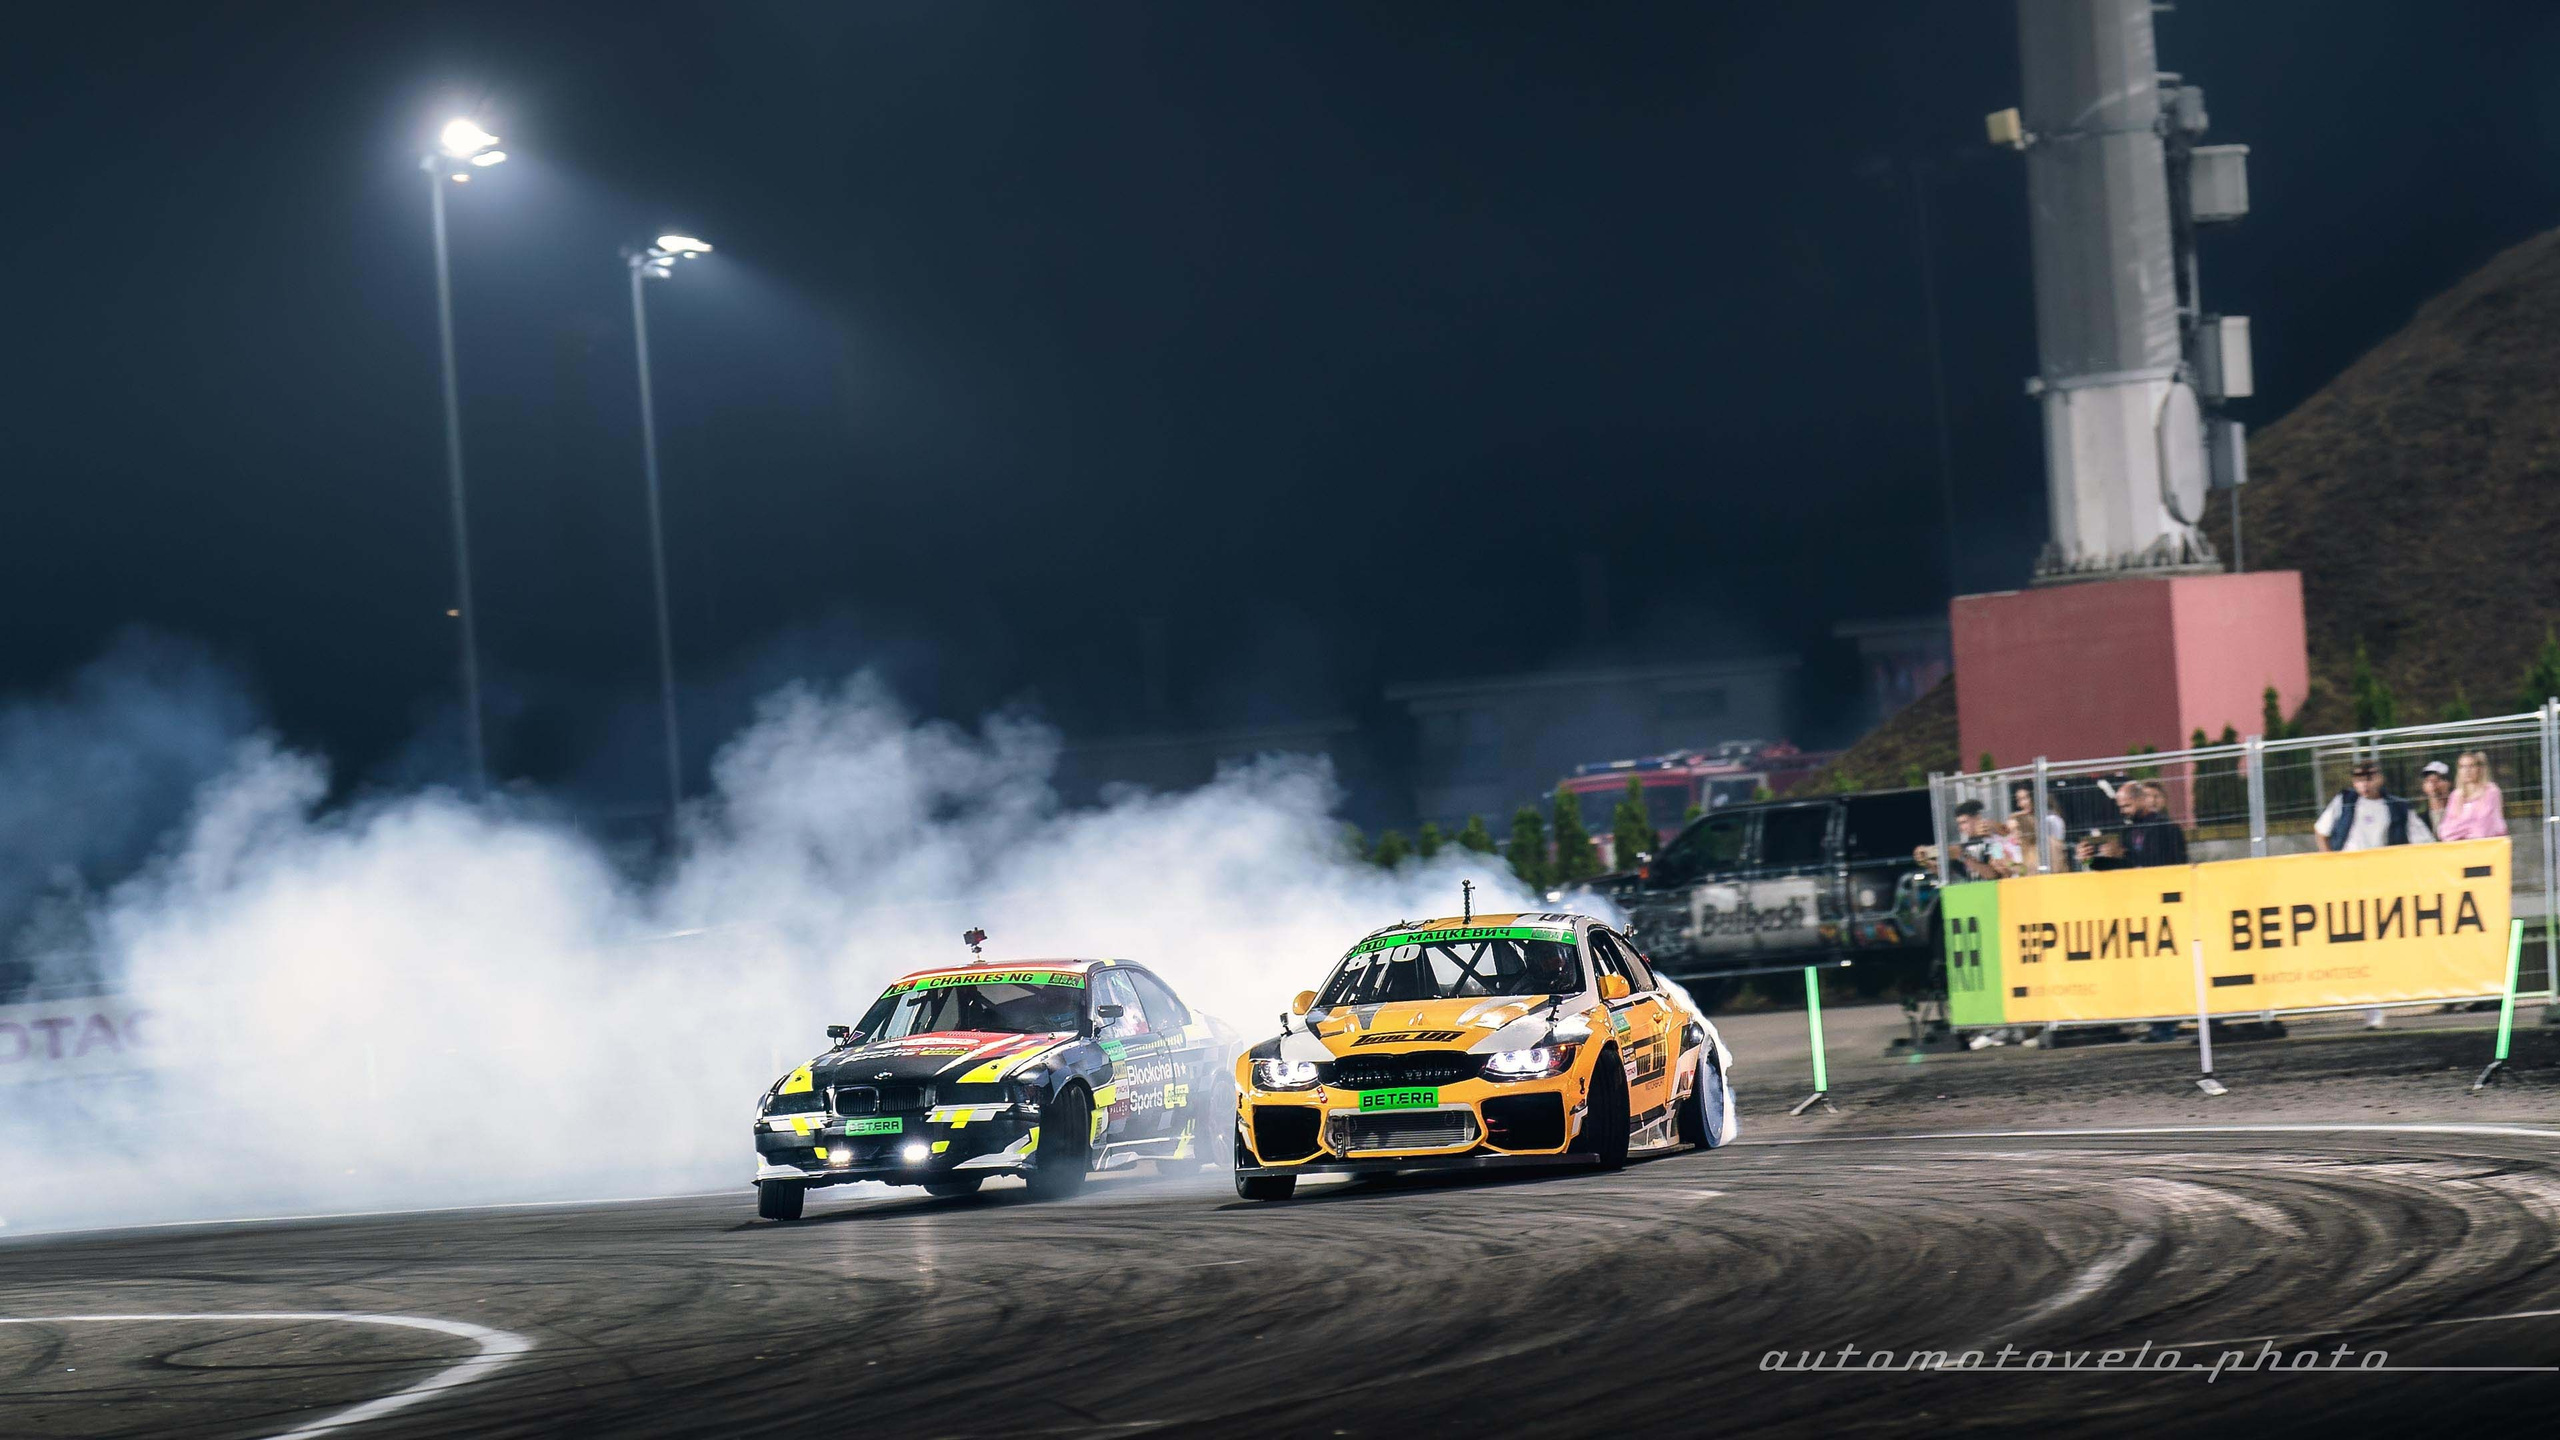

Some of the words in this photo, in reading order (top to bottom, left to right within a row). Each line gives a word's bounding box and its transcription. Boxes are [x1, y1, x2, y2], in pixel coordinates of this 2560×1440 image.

[1406, 928, 1511, 943] МАЦКЕВИЧ
[2231, 891, 2486, 951] ВЕРШИНА
[1345, 943, 1422, 972] 810
[929, 973, 1006, 987] CHARLES
[1008, 972, 1034, 983] NG
[1126, 1058, 1181, 1087] Blockchain
[1129, 1086, 1163, 1116] Sports
